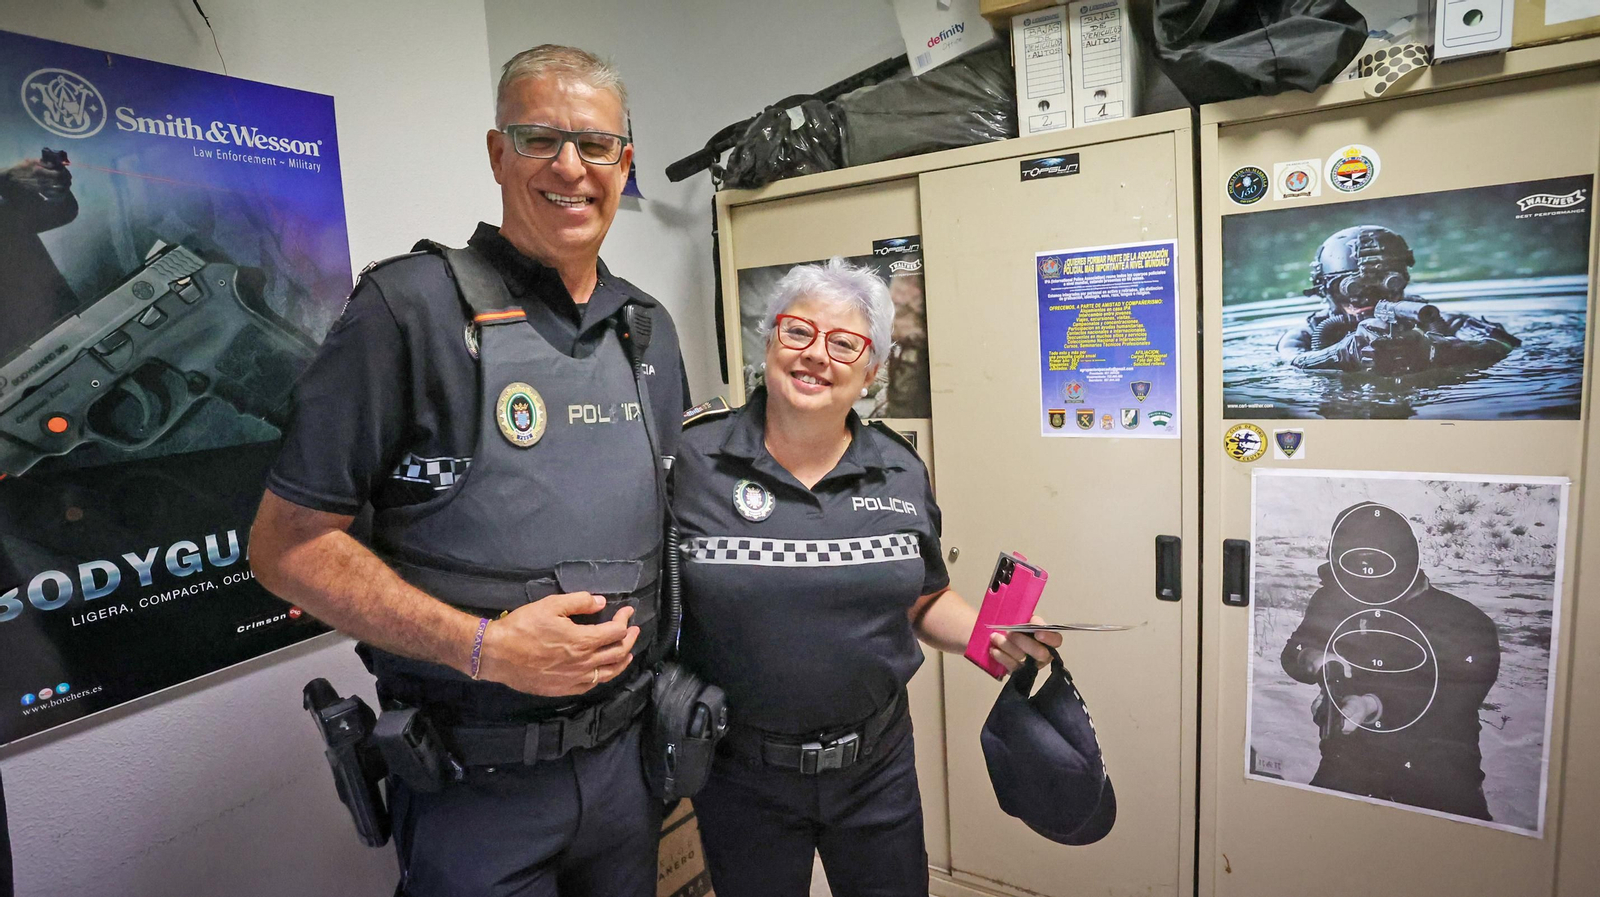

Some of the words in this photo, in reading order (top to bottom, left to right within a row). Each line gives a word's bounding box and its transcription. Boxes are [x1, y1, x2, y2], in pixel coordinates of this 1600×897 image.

[1083, 12, 1116, 24] BAJAS
[1028, 23, 1059, 36] BAJAS
[1082, 26, 1122, 40] VEHICULOS
[1090, 22, 1106, 31] DE
[927, 22, 964, 48] definity
[1097, 103, 1108, 117] 1
[1041, 115, 1052, 127] 2
[193, 146, 213, 158] Law
[217, 149, 277, 166] Enforcement
[288, 158, 321, 172] Military
[1241, 185, 1257, 198] 150
[1526, 197, 1574, 206] WALTHER
[1534, 208, 1585, 217] PERFORMANCE
[1087, 255, 1106, 264] FORMAR
[1107, 253, 1122, 262] PARTE
[1123, 253, 1129, 261] DE
[1130, 252, 1137, 260] LA
[1063, 265, 1084, 274] POLICIAL
[1095, 261, 1124, 272] IMPORTANTE
[1124, 261, 1128, 269] A
[1129, 259, 1144, 268] NIVEL
[852, 496, 917, 516] POLICIA
[72, 603, 134, 627] LIGERA,
[139, 581, 219, 609] COMPACTA,
[474, 622, 486, 651] GRAN
[22, 685, 103, 716] www.borchers.es
